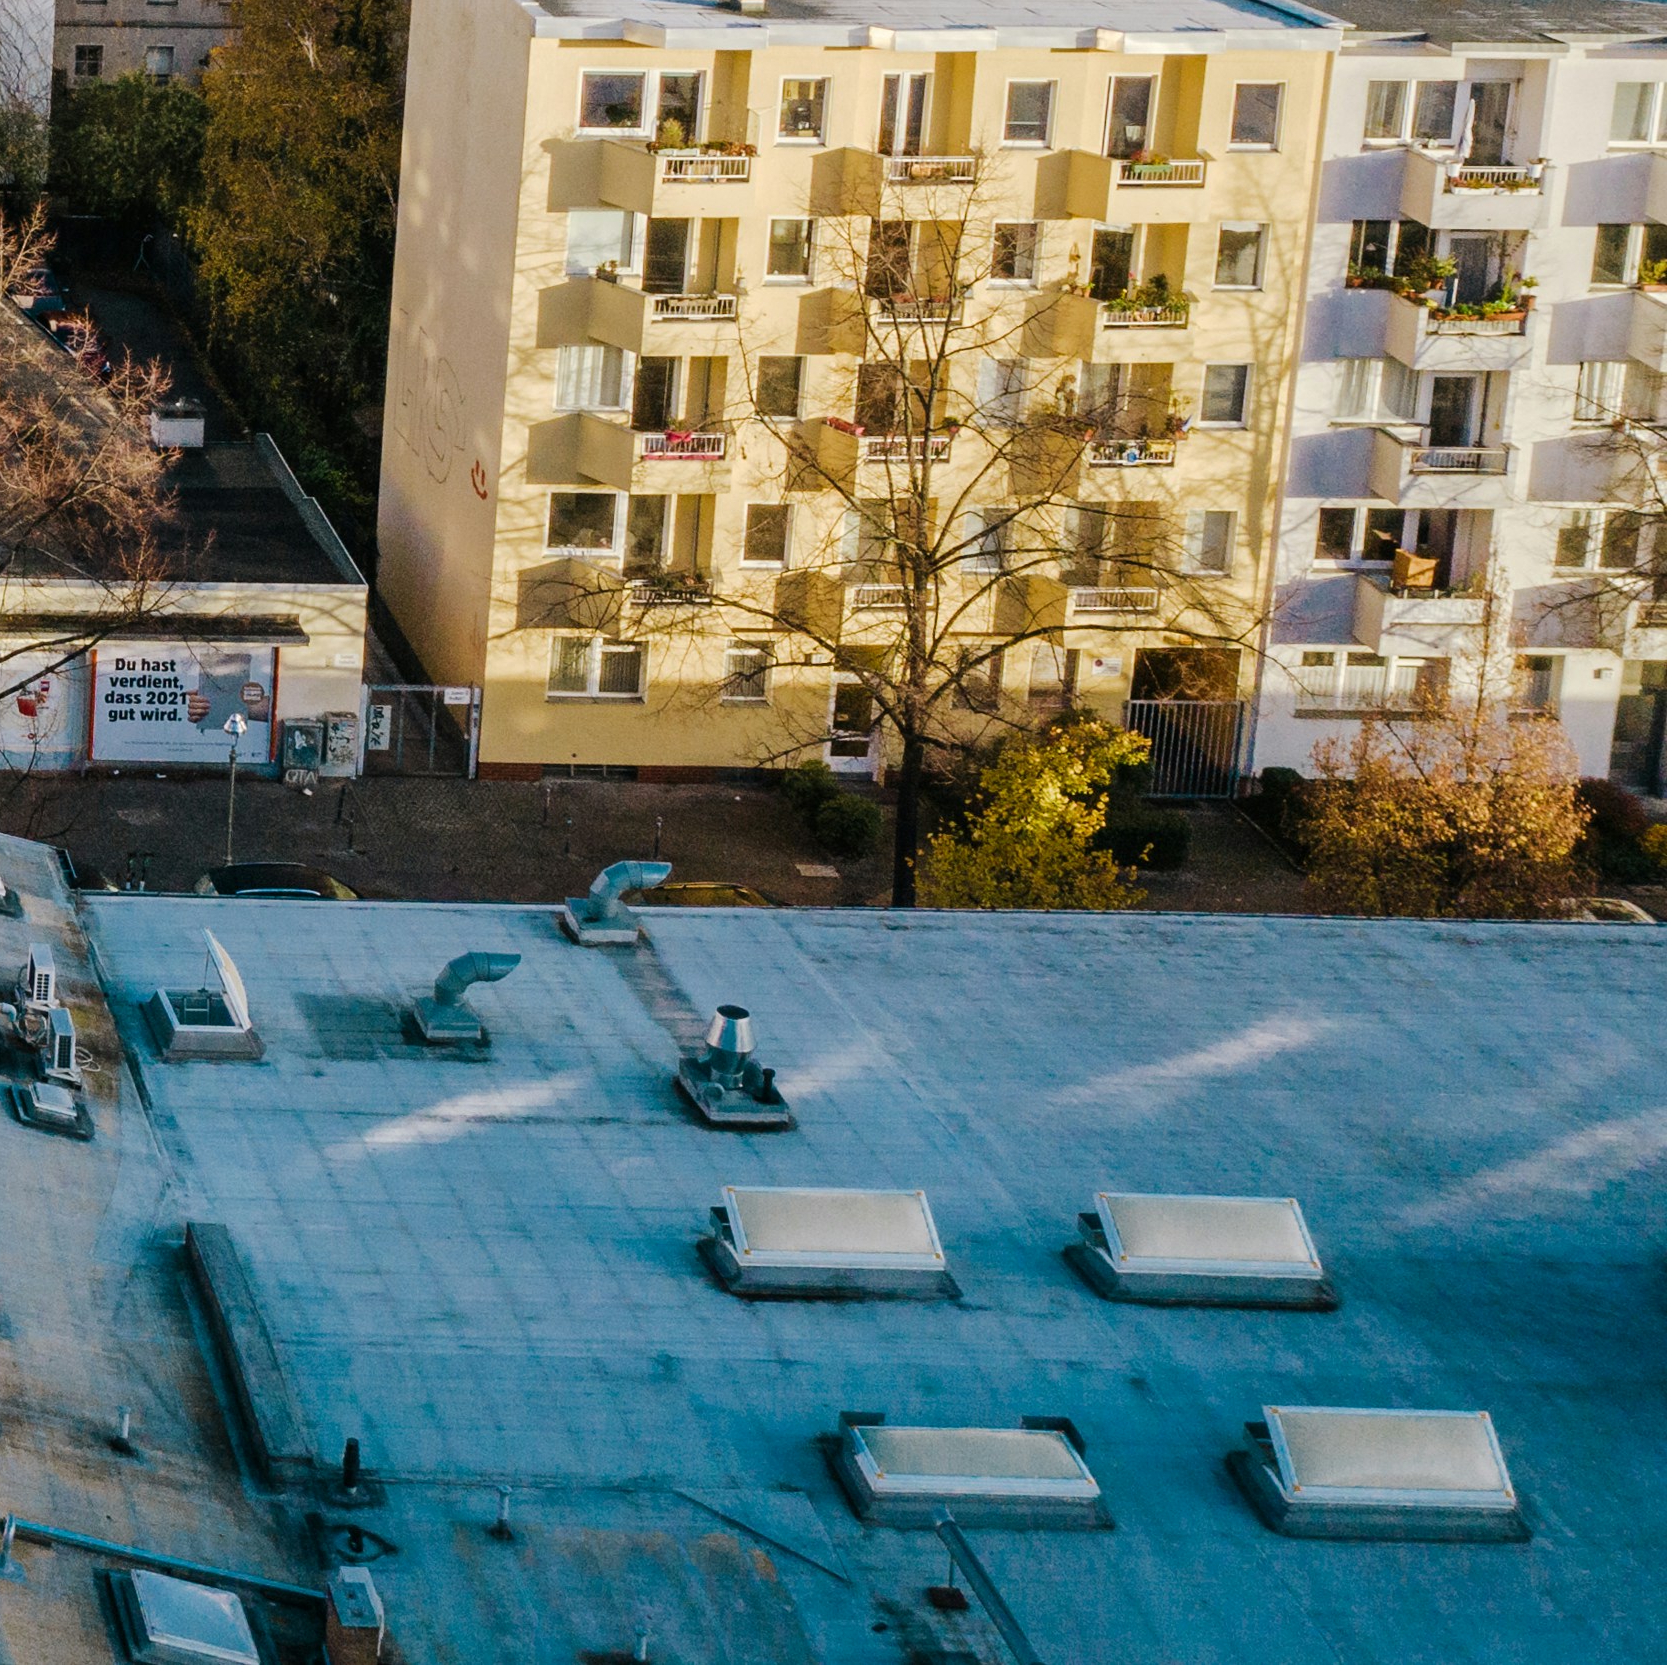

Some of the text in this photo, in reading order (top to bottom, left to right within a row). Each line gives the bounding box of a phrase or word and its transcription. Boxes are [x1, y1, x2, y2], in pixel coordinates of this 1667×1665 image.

[115, 658, 176, 672] Du hast
[110, 675, 184, 691] verdient,
[104, 691, 187, 705] dass 2021
[108, 708, 182, 722] gut wird.
